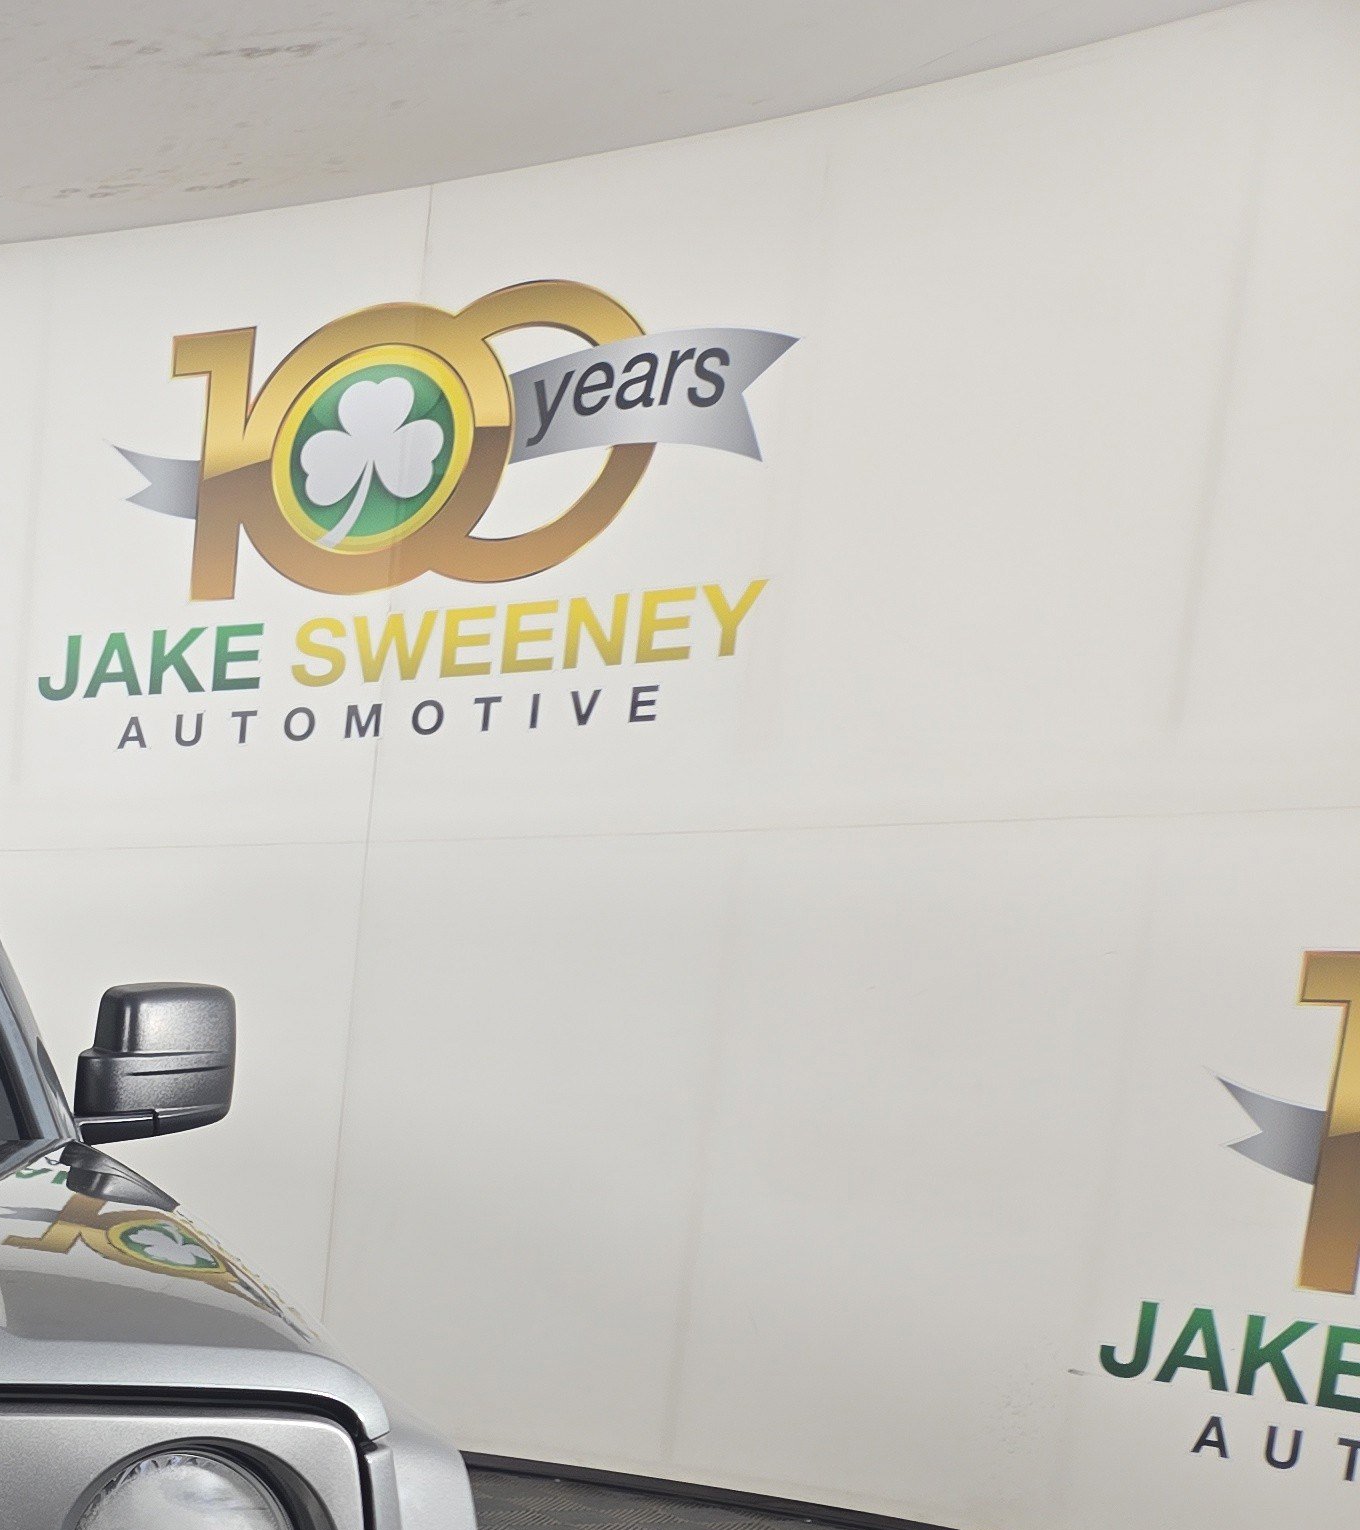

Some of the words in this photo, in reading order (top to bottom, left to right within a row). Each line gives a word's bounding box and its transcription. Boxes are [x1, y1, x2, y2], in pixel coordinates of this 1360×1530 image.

[526, 346, 732, 446] years
[37, 622, 265, 702] JAKE
[290, 578, 769, 688] SWEENEY
[116, 684, 661, 750] AUTOMOTIVE
